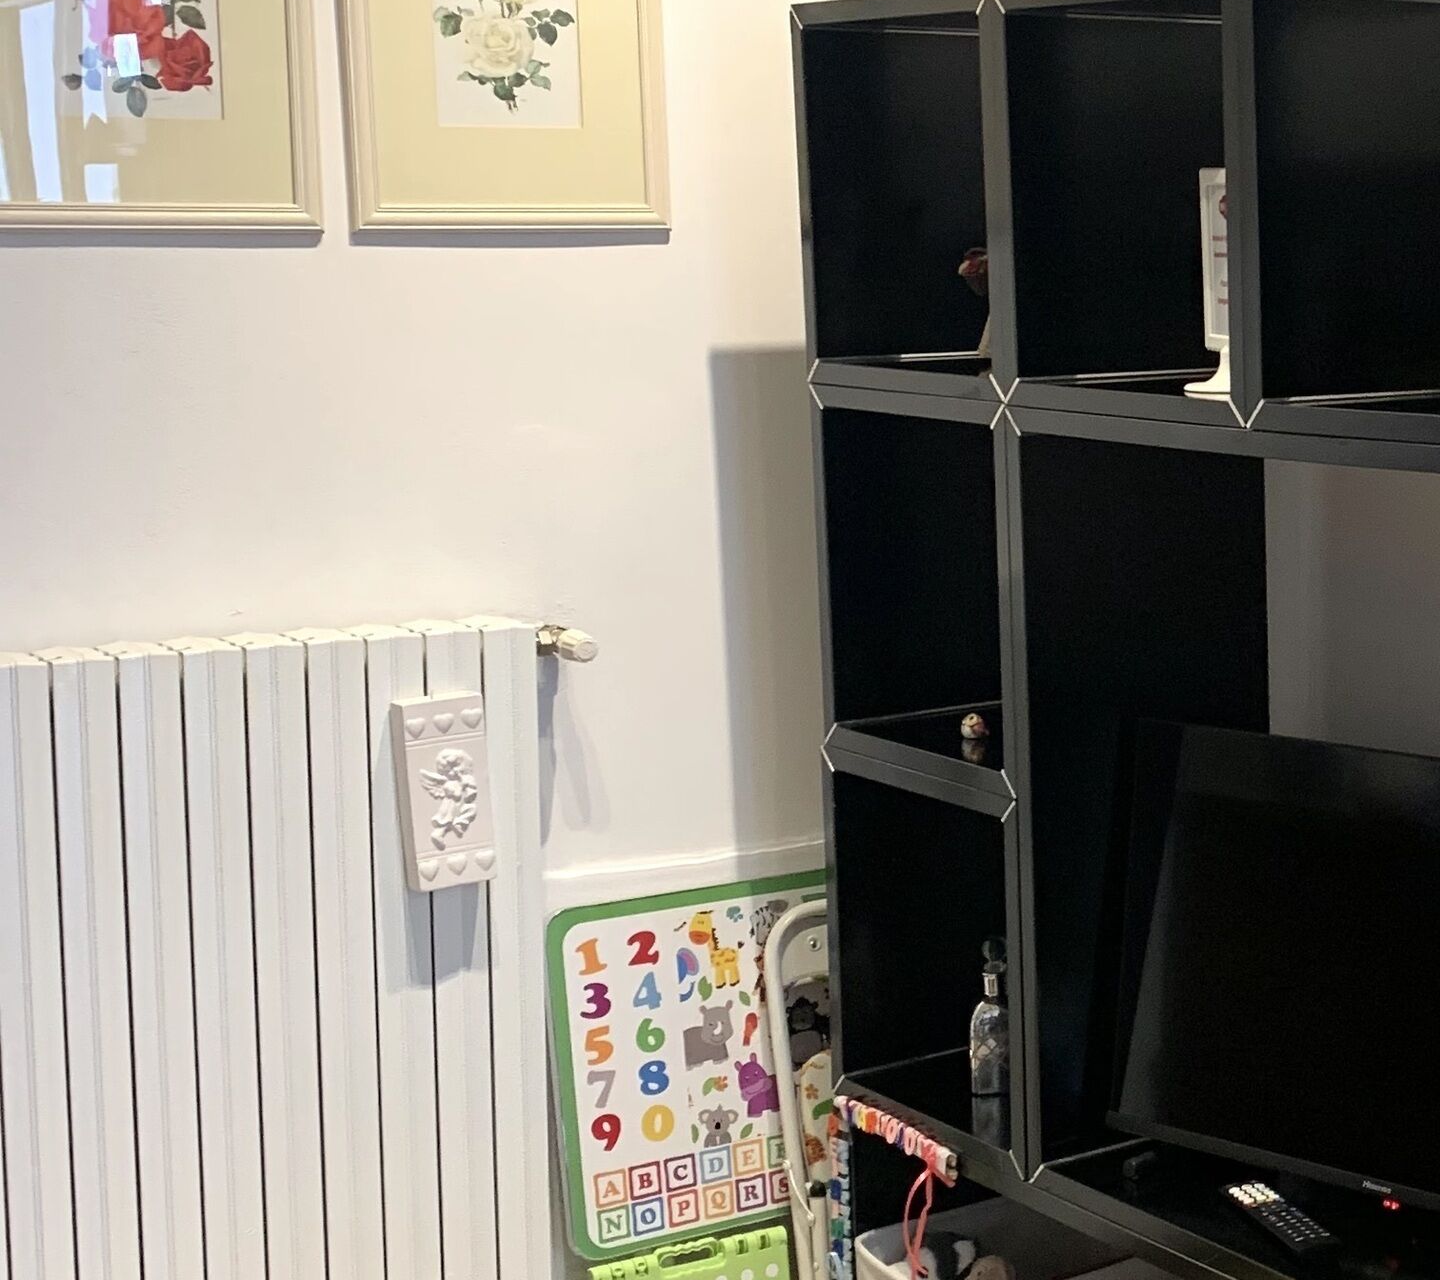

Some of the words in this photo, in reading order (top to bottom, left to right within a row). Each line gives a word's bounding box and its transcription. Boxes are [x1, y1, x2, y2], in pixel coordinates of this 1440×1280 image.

[575, 938, 607, 975] 1
[626, 930, 659, 966] 2
[580, 982, 611, 1019] 3
[633, 971, 661, 1010] 4
[585, 1025, 614, 1065] 5
[636, 1018, 665, 1052] 6
[587, 1070, 616, 1108] 7
[638, 1060, 669, 1095] 8
[591, 1113, 621, 1151] 9
[641, 1104, 675, 1142] 0
[603, 1185, 621, 1198] A
[638, 1173, 653, 1190] B
[673, 1164, 687, 1181] C
[708, 1157, 723, 1174] D
[742, 1149, 755, 1166] E
[606, 1215, 622, 1234] N
[640, 1207, 657, 1225] O
[677, 1200, 690, 1217] P
[711, 1191, 727, 1208] Q
[743, 1185, 759, 1201] R
